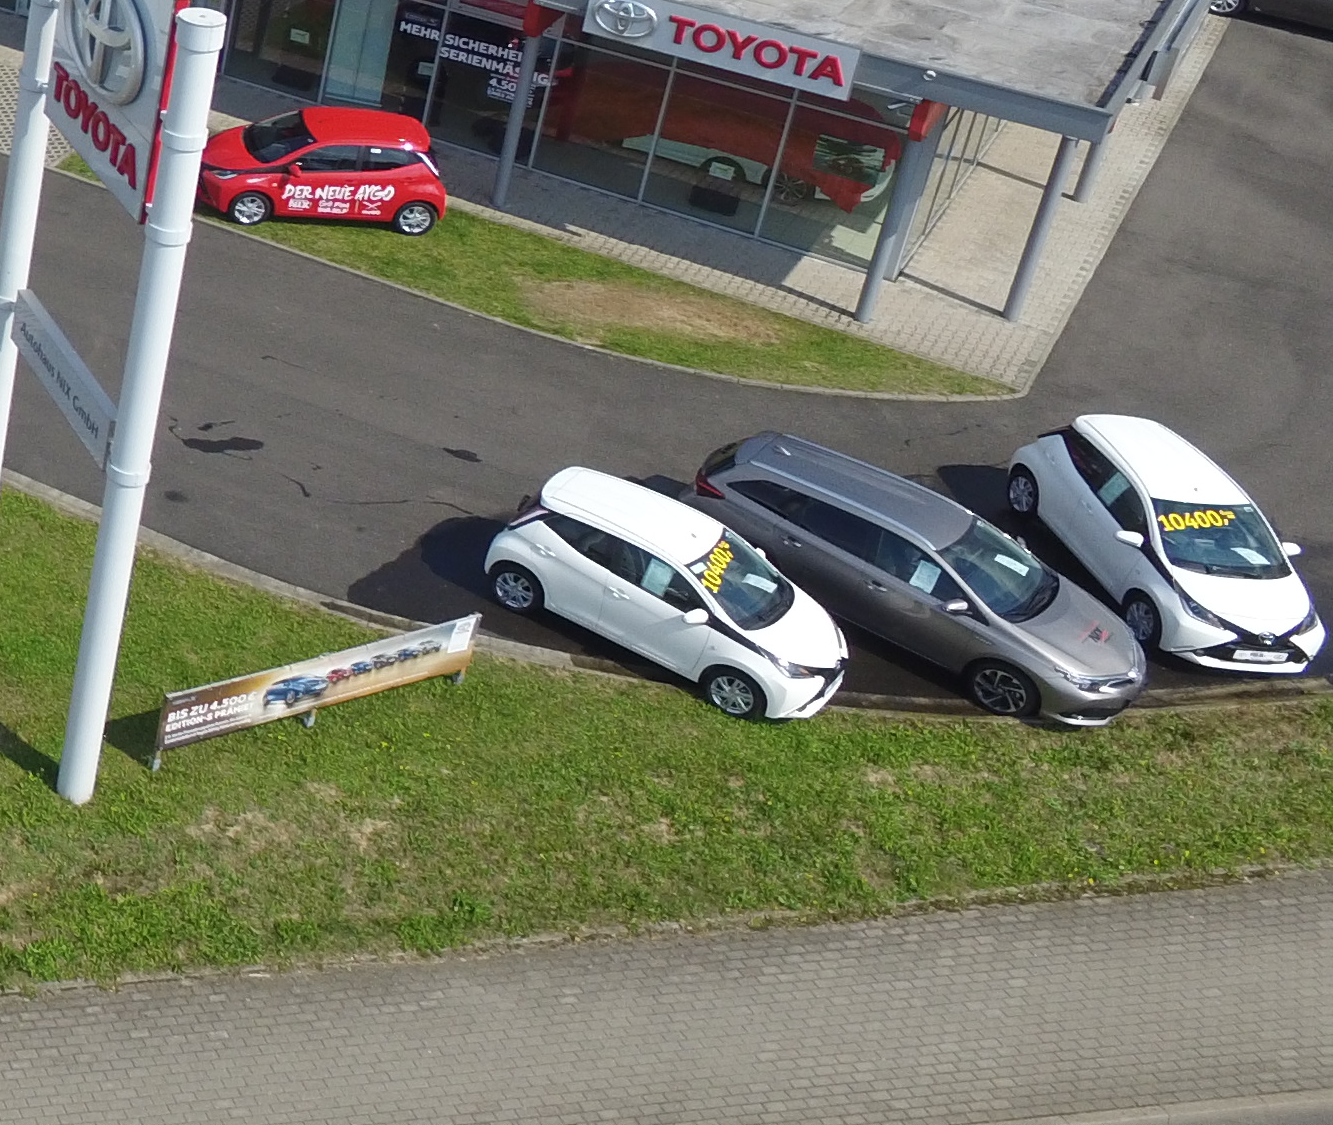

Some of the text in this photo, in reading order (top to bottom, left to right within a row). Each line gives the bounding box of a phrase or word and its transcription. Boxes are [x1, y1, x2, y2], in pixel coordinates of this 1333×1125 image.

[399, 20, 523, 63] MEHR SICHERHEI
[669, 14, 844, 87] TOYOTA
[54, 61, 137, 191] TOYOTA
[282, 184, 395, 201] DER NEUE AYGO
[20, 322, 99, 439] Autohaus NIX GmbH
[165, 712, 213, 733] EDITION-S
[167, 707, 189, 723] BIS
[189, 703, 209, 716] ZU
